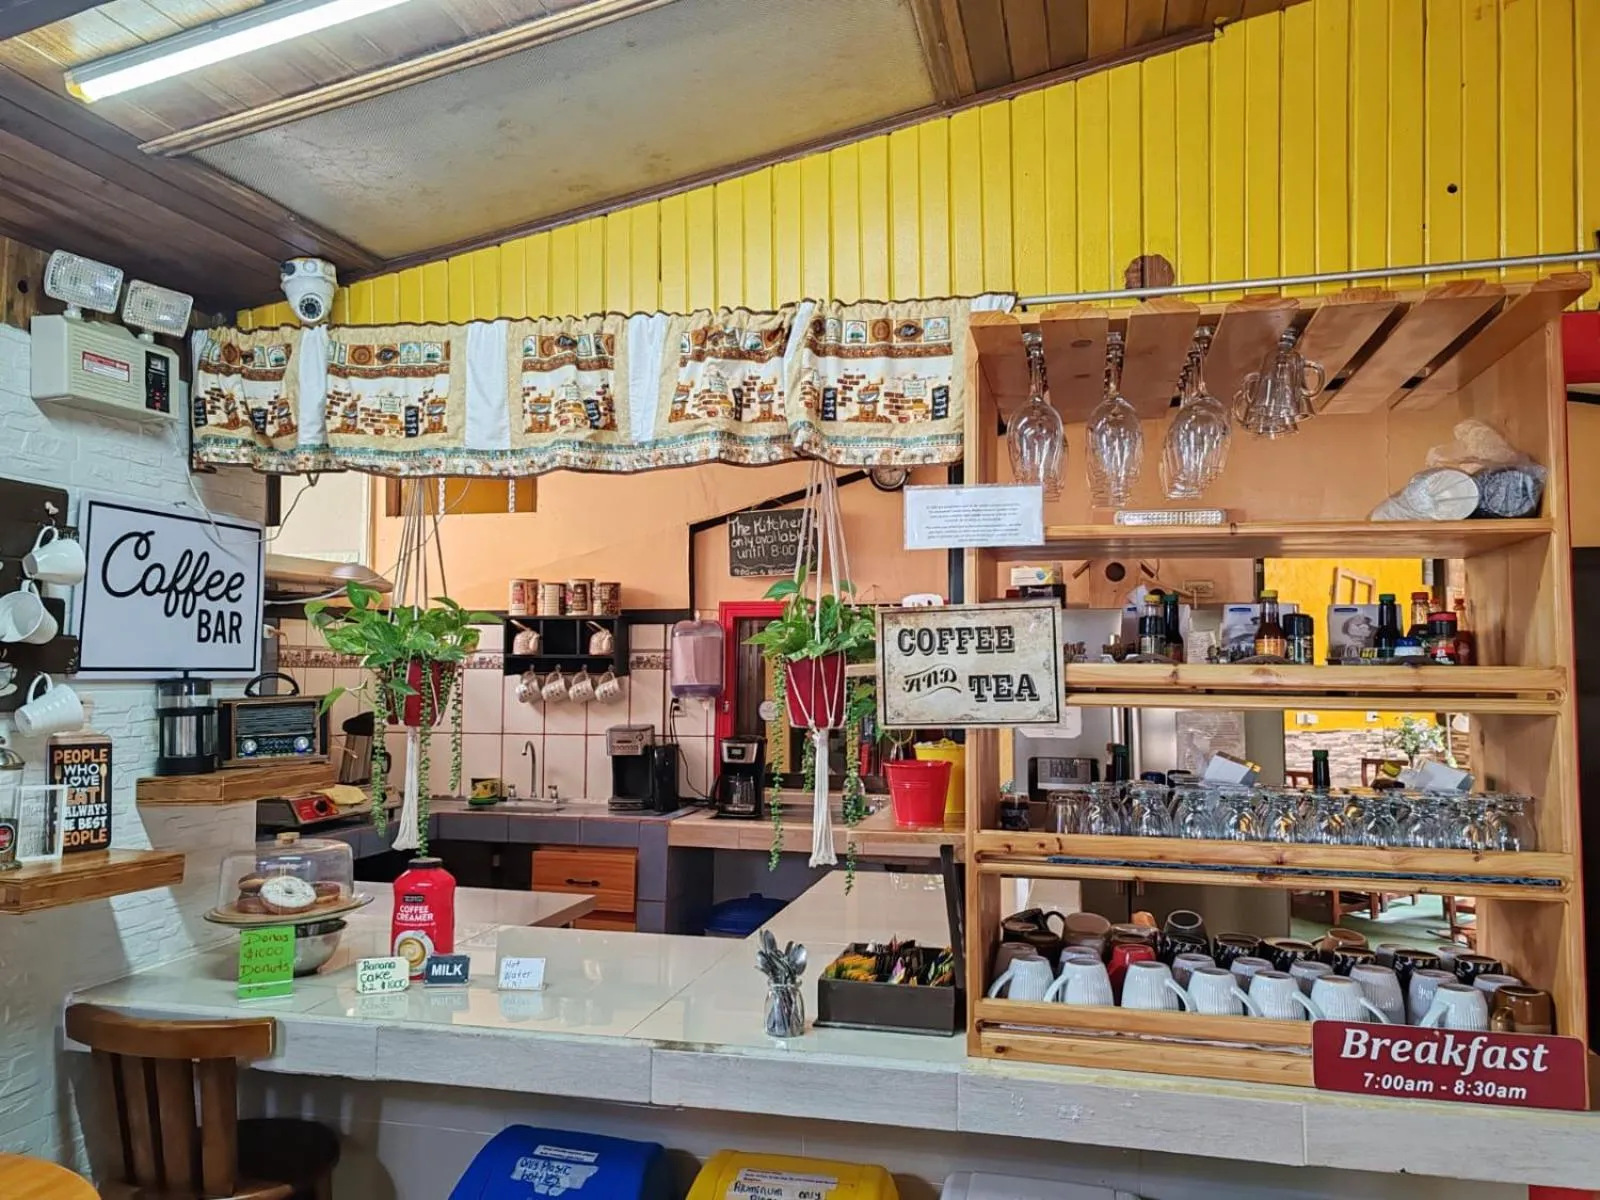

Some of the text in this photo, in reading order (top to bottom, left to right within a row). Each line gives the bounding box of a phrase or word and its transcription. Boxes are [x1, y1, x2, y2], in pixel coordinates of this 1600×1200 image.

[728, 516, 751, 536] The
[731, 536, 753, 549] only
[737, 544, 765, 559] until
[102, 530, 245, 618] Coffee
[197, 609, 242, 644] BAR
[897, 625, 1015, 656] COFFEE
[903, 668, 1040, 702] AND TEA
[53, 748, 109, 764] PEOPLE
[63, 763, 100, 776] WHO
[63, 775, 100, 787] LOVE
[66, 786, 101, 806] EAT
[63, 803, 108, 818] ALWAYS
[78, 816, 108, 830] BEST
[62, 828, 108, 847] EOPLE
[396, 912, 434, 921] CREAMER
[399, 905, 429, 914] COFFEE
[431, 964, 463, 976] MILK
[1340, 1028, 1549, 1076] Breakfast
[1363, 1072, 1434, 1093] 7:00am
[1453, 1079, 1528, 1100] 8:30am
